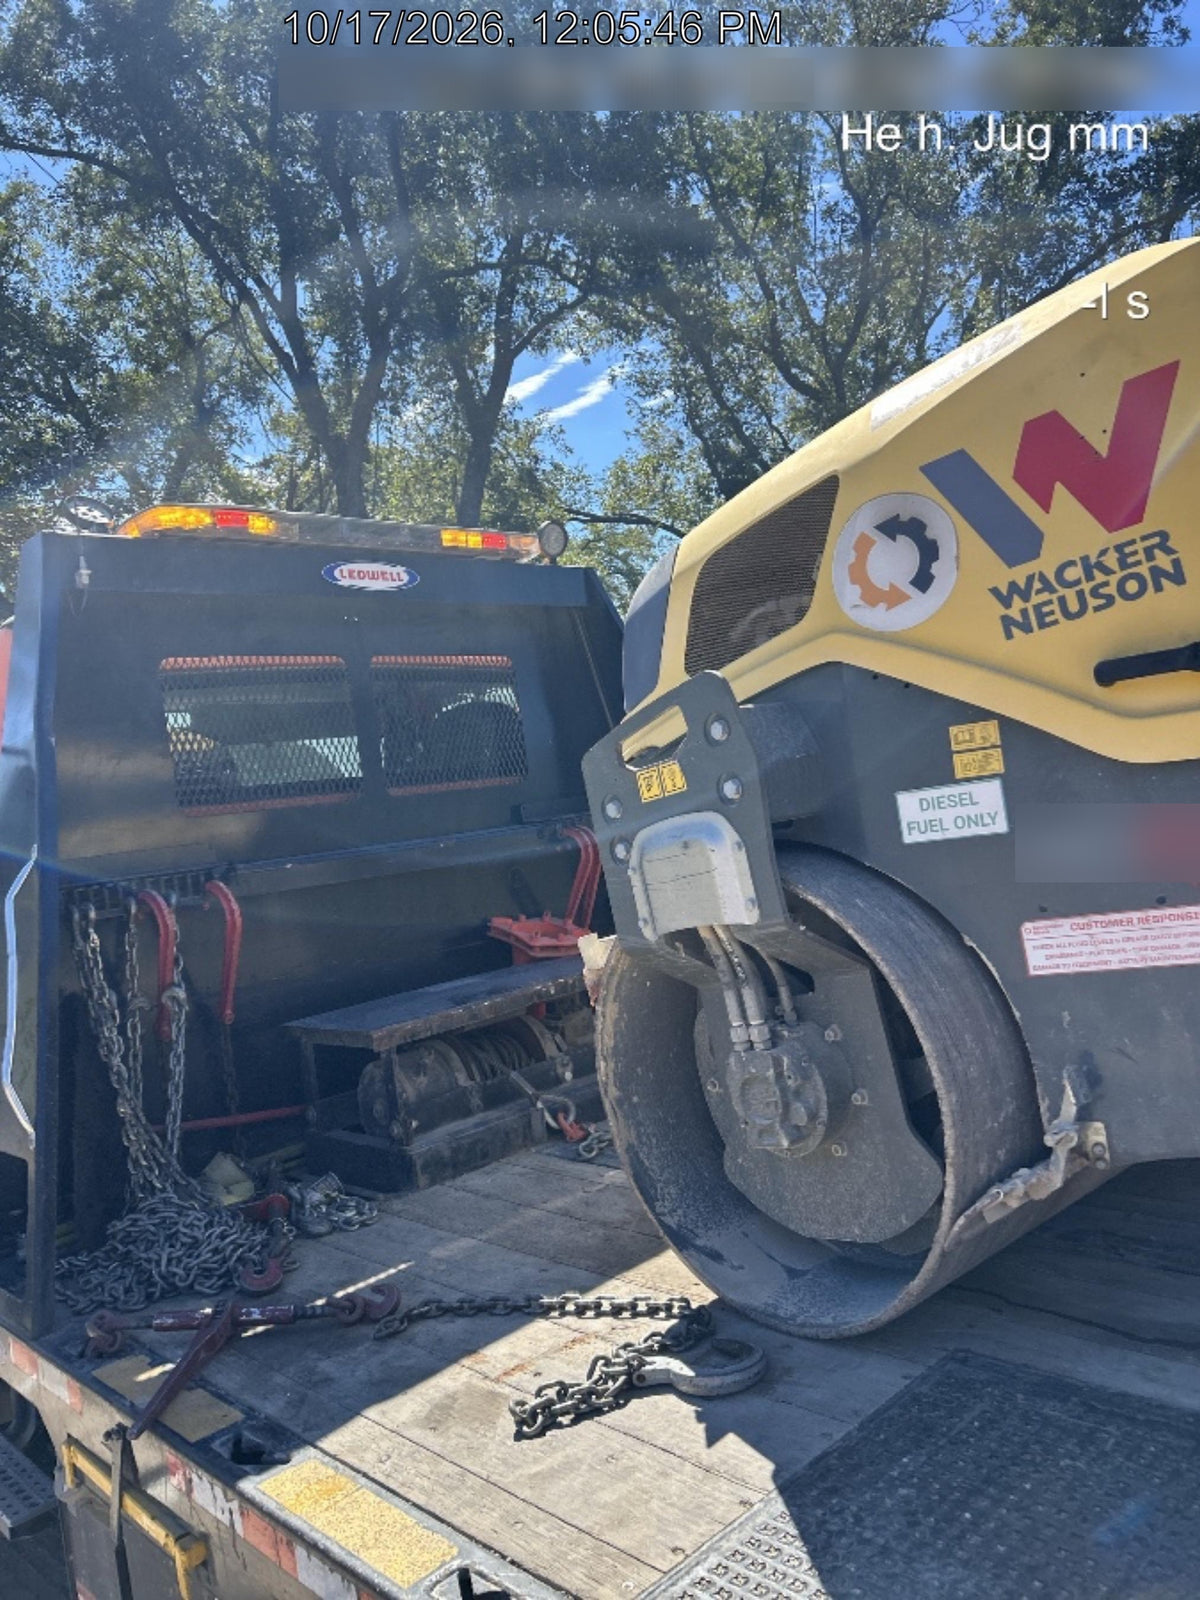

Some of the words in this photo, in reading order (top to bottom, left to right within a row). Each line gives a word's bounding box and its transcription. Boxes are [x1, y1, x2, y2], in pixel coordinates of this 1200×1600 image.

[339, 568, 404, 582] LEDWELL
[987, 529, 1179, 610] WACKER
[1000, 556, 1187, 640] NEUSON
[918, 791, 980, 813] DIESEL
[906, 818, 950, 836] FUEL
[954, 811, 998, 830] ONLY
[1070, 916, 1134, 931] CUSTOMER
